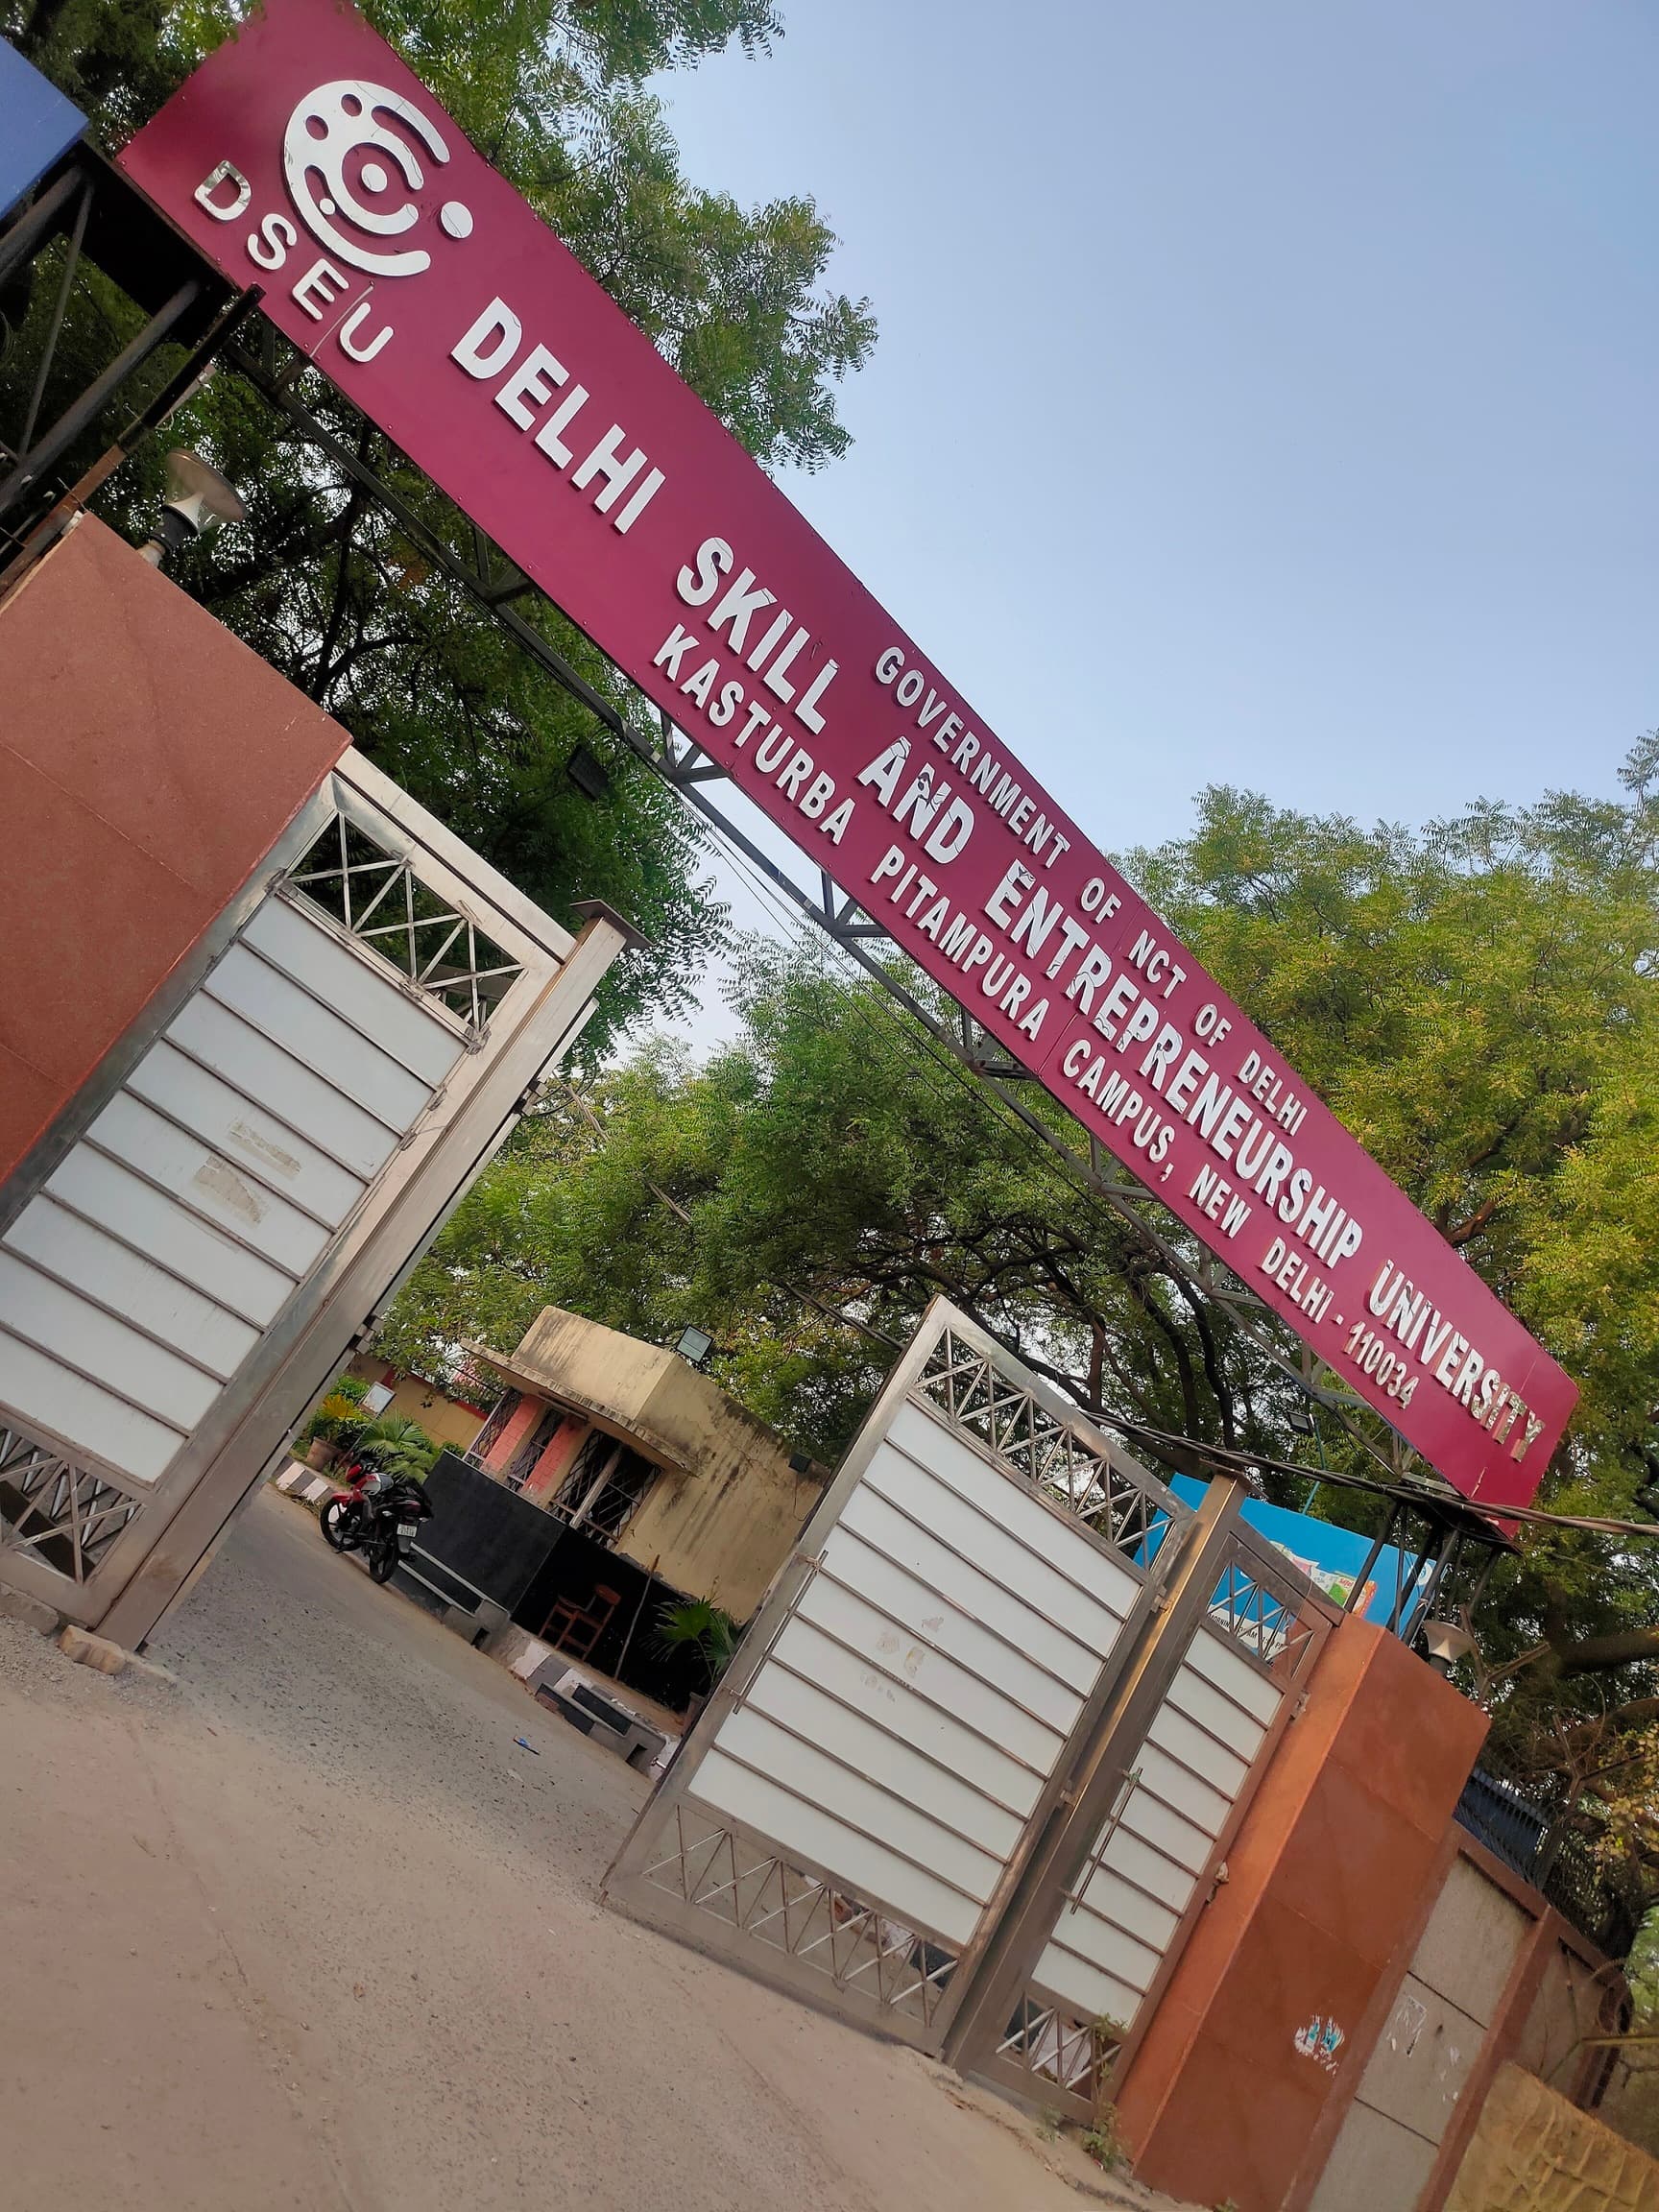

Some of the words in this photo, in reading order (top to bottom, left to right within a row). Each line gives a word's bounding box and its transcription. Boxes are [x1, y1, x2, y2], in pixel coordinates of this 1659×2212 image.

[194, 159, 393, 363] DSEU
[449, 296, 666, 535] DELHI
[676, 537, 838, 735] SKILL
[856, 735, 975, 864] AND
[984, 858, 1363, 1271] ENTREPRENEURSHIP
[1368, 1259, 1546, 1463] UNIVERSITY
[651, 623, 856, 847] KASTURBA
[869, 844, 1051, 1043] PITAMPURA
[1061, 1038, 1176, 1183] CAMPUS,
[1188, 1163, 1252, 1239] NEW
[1260, 1236, 1334, 1325] DELHI
[1344, 1320, 1421, 1410] 110034
[875, 646, 1070, 870] GOVERNMENT
[1080, 877, 1123, 924] OF
[1128, 928, 1187, 999] NCT
[1193, 1002, 1233, 1048] OF
[1238, 1049, 1308, 1138] DELHI
